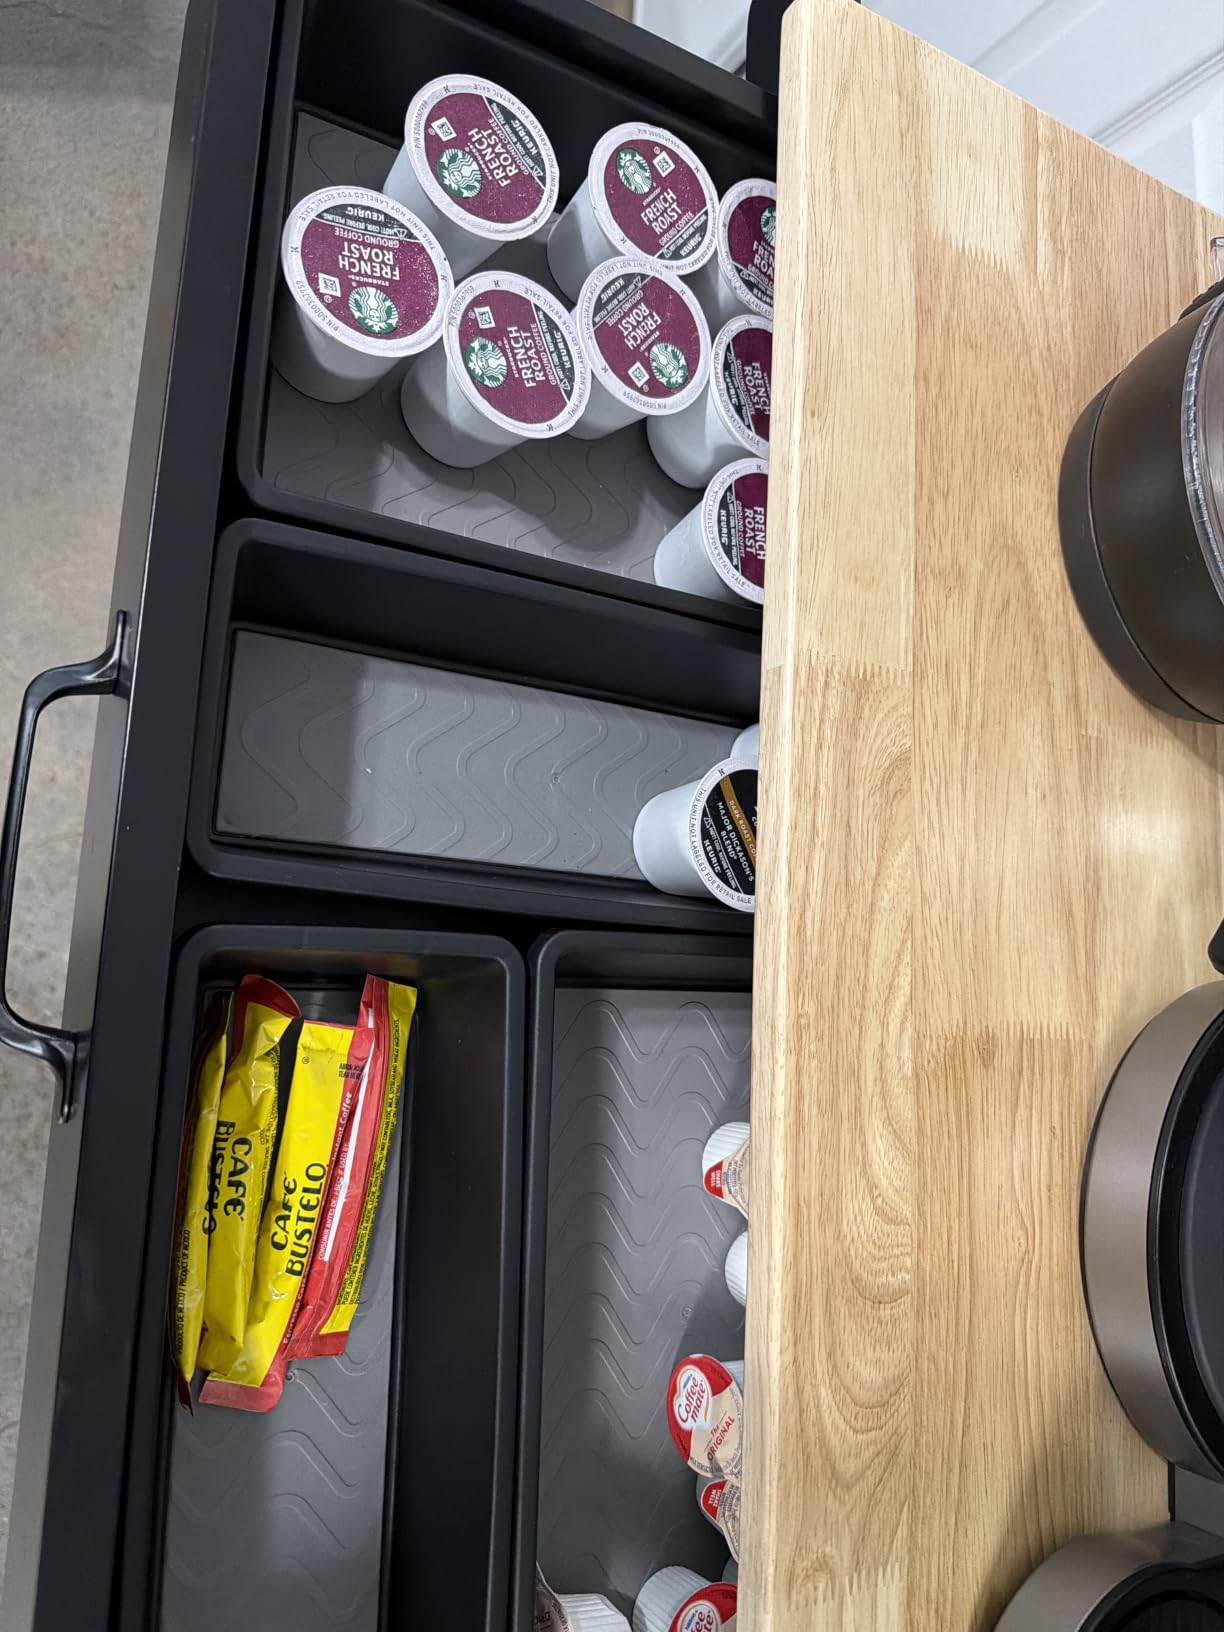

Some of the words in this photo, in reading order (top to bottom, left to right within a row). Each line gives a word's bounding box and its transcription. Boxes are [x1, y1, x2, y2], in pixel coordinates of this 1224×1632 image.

[488, 118, 509, 144] COFFEE
[512, 120, 538, 155] KEURIG
[468, 128, 511, 187] FRENCH
[481, 129, 518, 179] ROAST
[507, 144, 529, 176] GROUND
[346, 206, 385, 223] KEURIG
[390, 202, 407, 217] NOT
[640, 188, 678, 226] FRENCH
[651, 202, 682, 236] ROAST
[334, 226, 363, 240] COFFEE
[407, 217, 423, 233] UNIT
[659, 227, 678, 246] GROUND
[675, 211, 695, 231] COFFEE
[341, 241, 394, 265] ROAST
[364, 234, 400, 249] GROUND
[422, 233, 436, 251] THIS
[679, 233, 702, 257] KEURIG
[753, 240, 775, 267] FREN
[338, 255, 400, 281] FRENCH
[747, 263, 769, 286] GROUND
[754, 253, 775, 280] ROA
[600, 277, 625, 304] KEURIG
[622, 289, 644, 312] GROUND
[542, 299, 562, 319] RETAIL
[605, 309, 624, 327] COFFEE
[617, 301, 651, 338] ROAST
[530, 323, 544, 352] COFFEE
[623, 311, 662, 351] FRENCH
[507, 326, 537, 389] FRENCH
[521, 330, 546, 382] ROAST
[555, 331, 571, 369] KEURIG
[540, 352, 557, 386] GROUND
[736, 360, 746, 391] GROUND
[724, 371, 738, 406] KEURIG
[743, 365, 763, 410] ROAST
[567, 401, 579, 417] THIS
[720, 509, 728, 546] KEURIG
[735, 500, 744, 532] GROUND
[744, 508, 756, 556] ROAST
[738, 532, 746, 558] COFFEE
[754, 506, 766, 560] FRENCH
[715, 552, 731, 575] RETAIL
[730, 573, 746, 589] SALE
[695, 787, 707, 802] THIS
[689, 822, 697, 840] NOT
[729, 799, 740, 818] DARK
[739, 819, 751, 845] ROAST
[690, 840, 706, 872] LABELED
[703, 839, 720, 874] KEURIG
[716, 801, 733, 832] MAJOR
[729, 831, 755, 882] DICKASON'S
[704, 871, 716, 886] FOR
[715, 885, 735, 901] RETAIL
[736, 895, 752, 905] SALE
[339, 1092, 353, 1130] Coffee
[222, 1136, 253, 1222] CAFÉ
[271, 1168, 297, 1252] CAFÉ
[285, 1162, 326, 1278] BUSTELO
[316, 1228, 330, 1261] CONSUMIR
[324, 1207, 335, 1228] ANTES
[338, 1151, 347, 1169] USED
[677, 1376, 700, 1424] Coffee
[690, 1383, 706, 1425] mate
[706, 1415, 735, 1463] ORIGINAL
[710, 1424, 720, 1438] The
